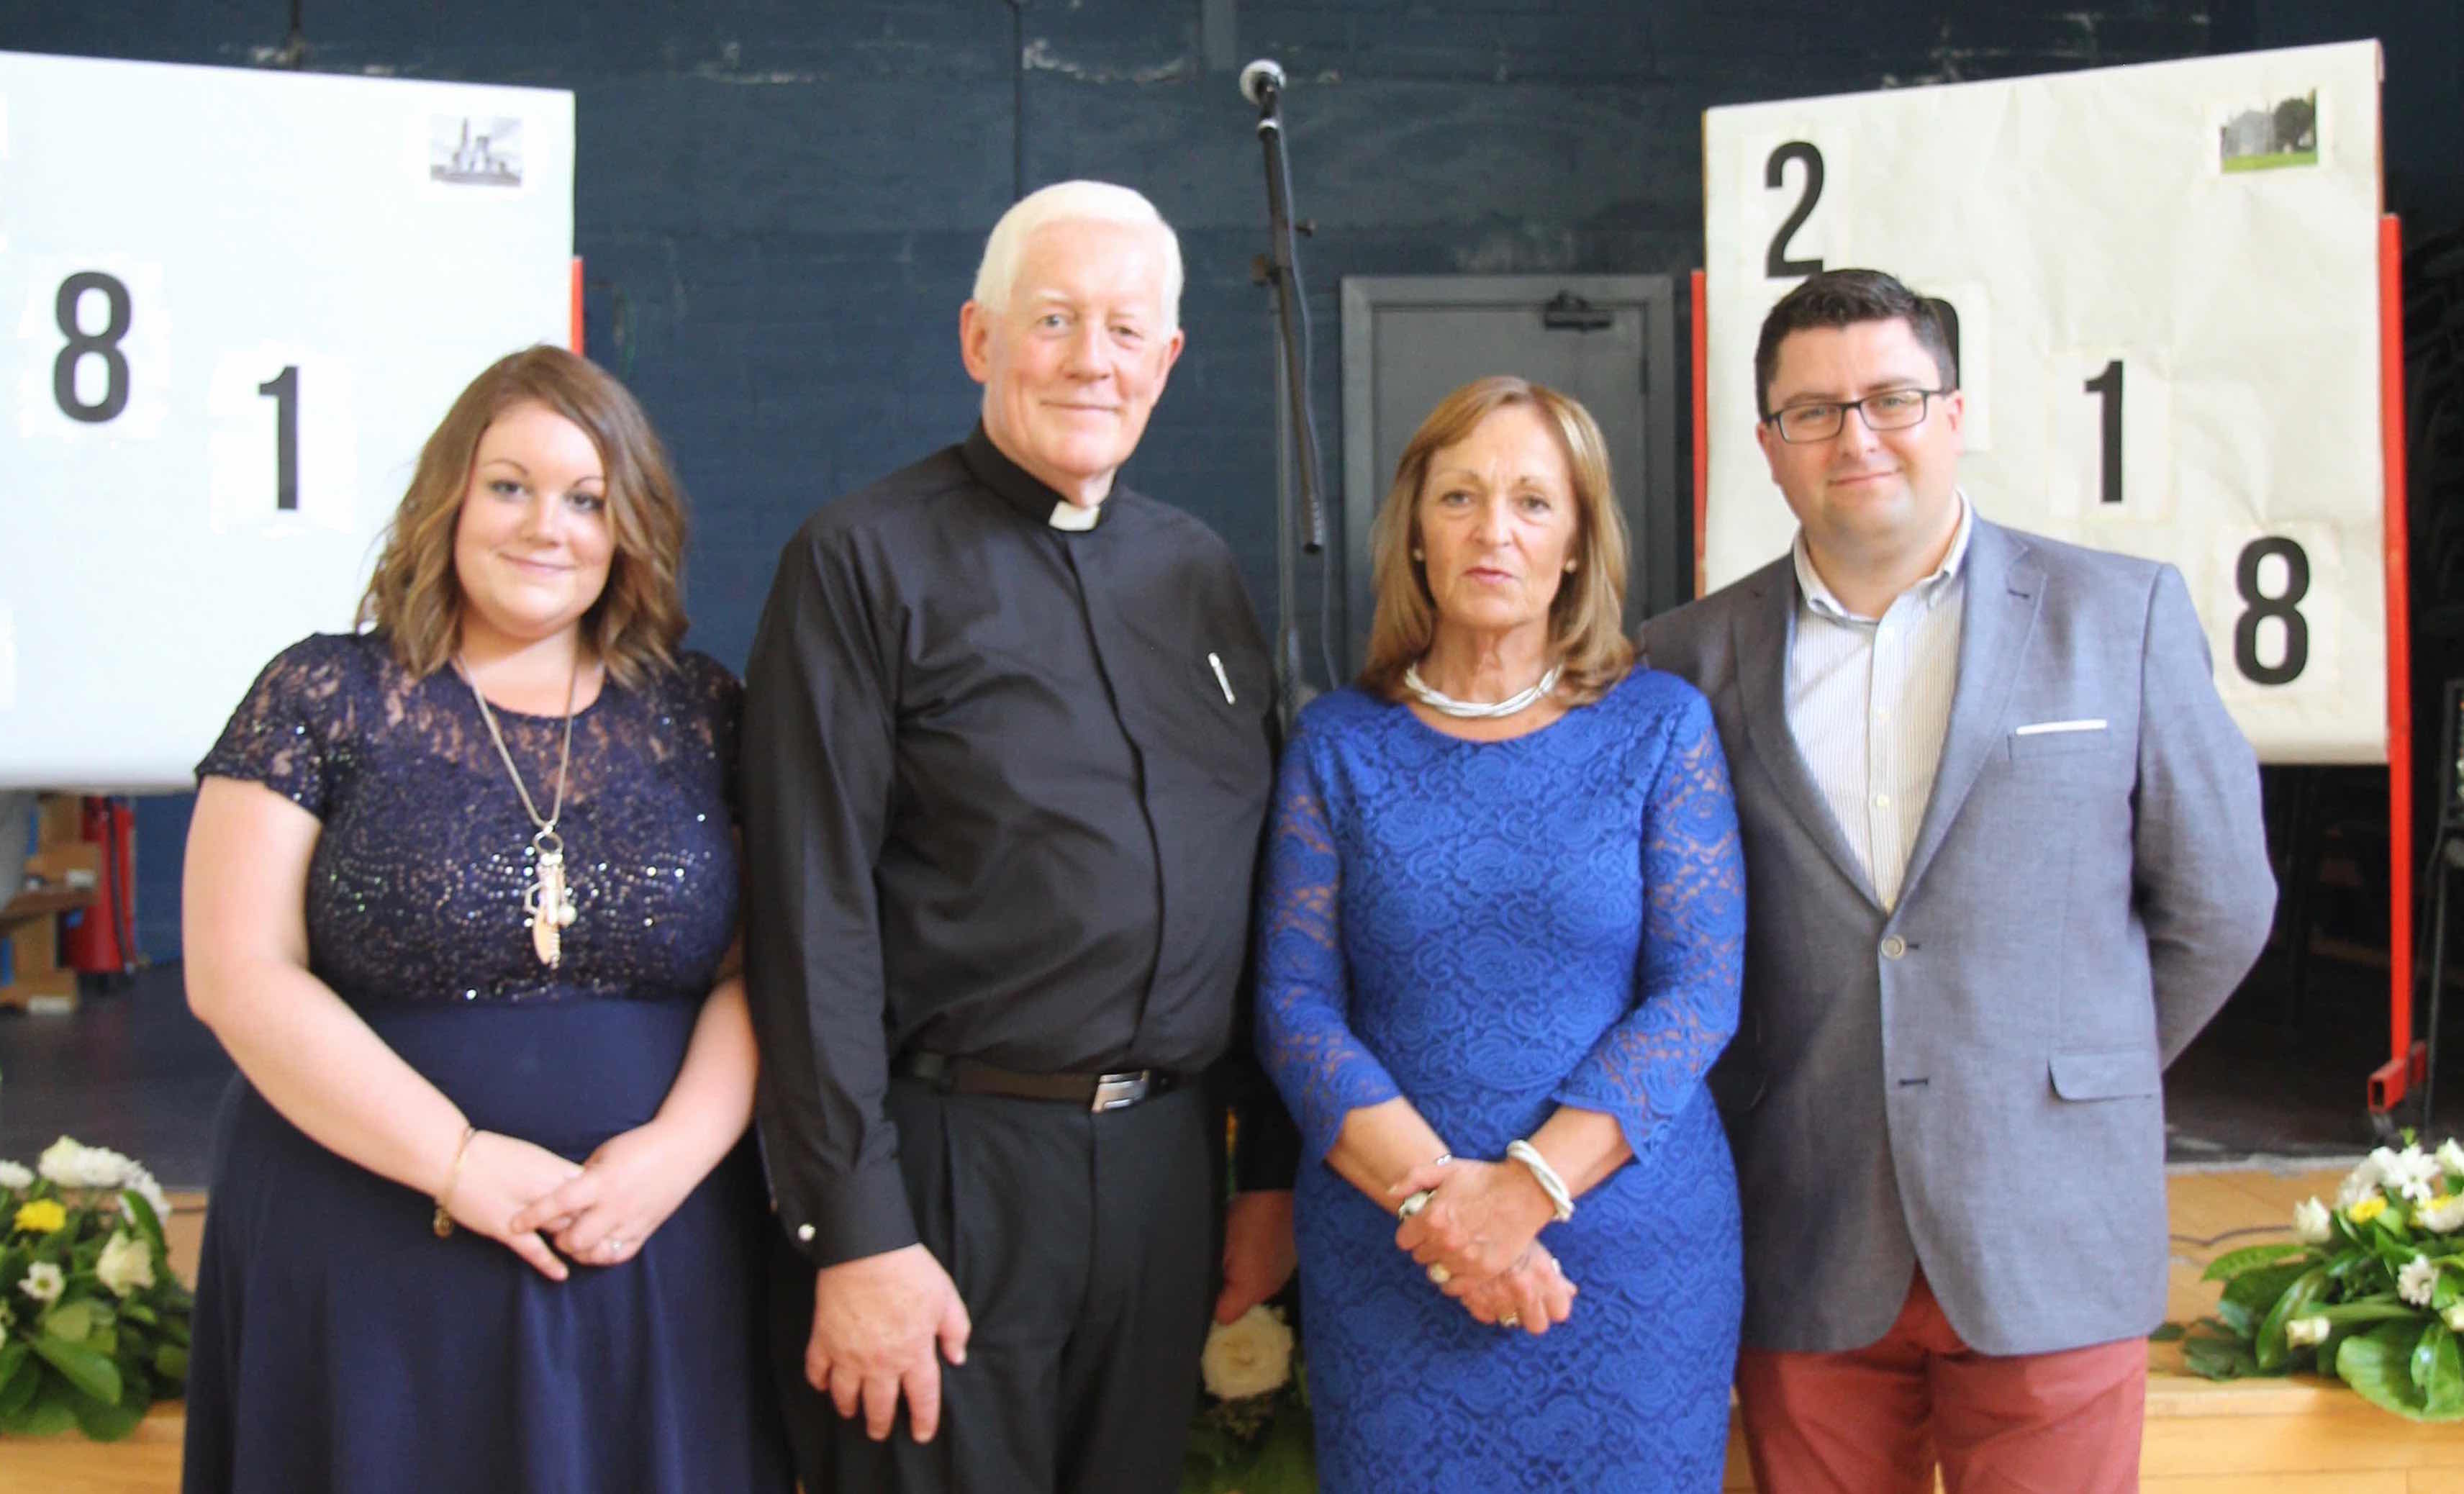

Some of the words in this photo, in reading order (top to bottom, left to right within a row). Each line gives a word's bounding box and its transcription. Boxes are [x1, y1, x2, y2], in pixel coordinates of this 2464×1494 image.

[1765, 140, 1825, 279] 2
[53, 271, 132, 424] 8
[258, 366, 299, 510] 1
[2084, 360, 2124, 504] 1
[2234, 535, 2311, 686] 8
